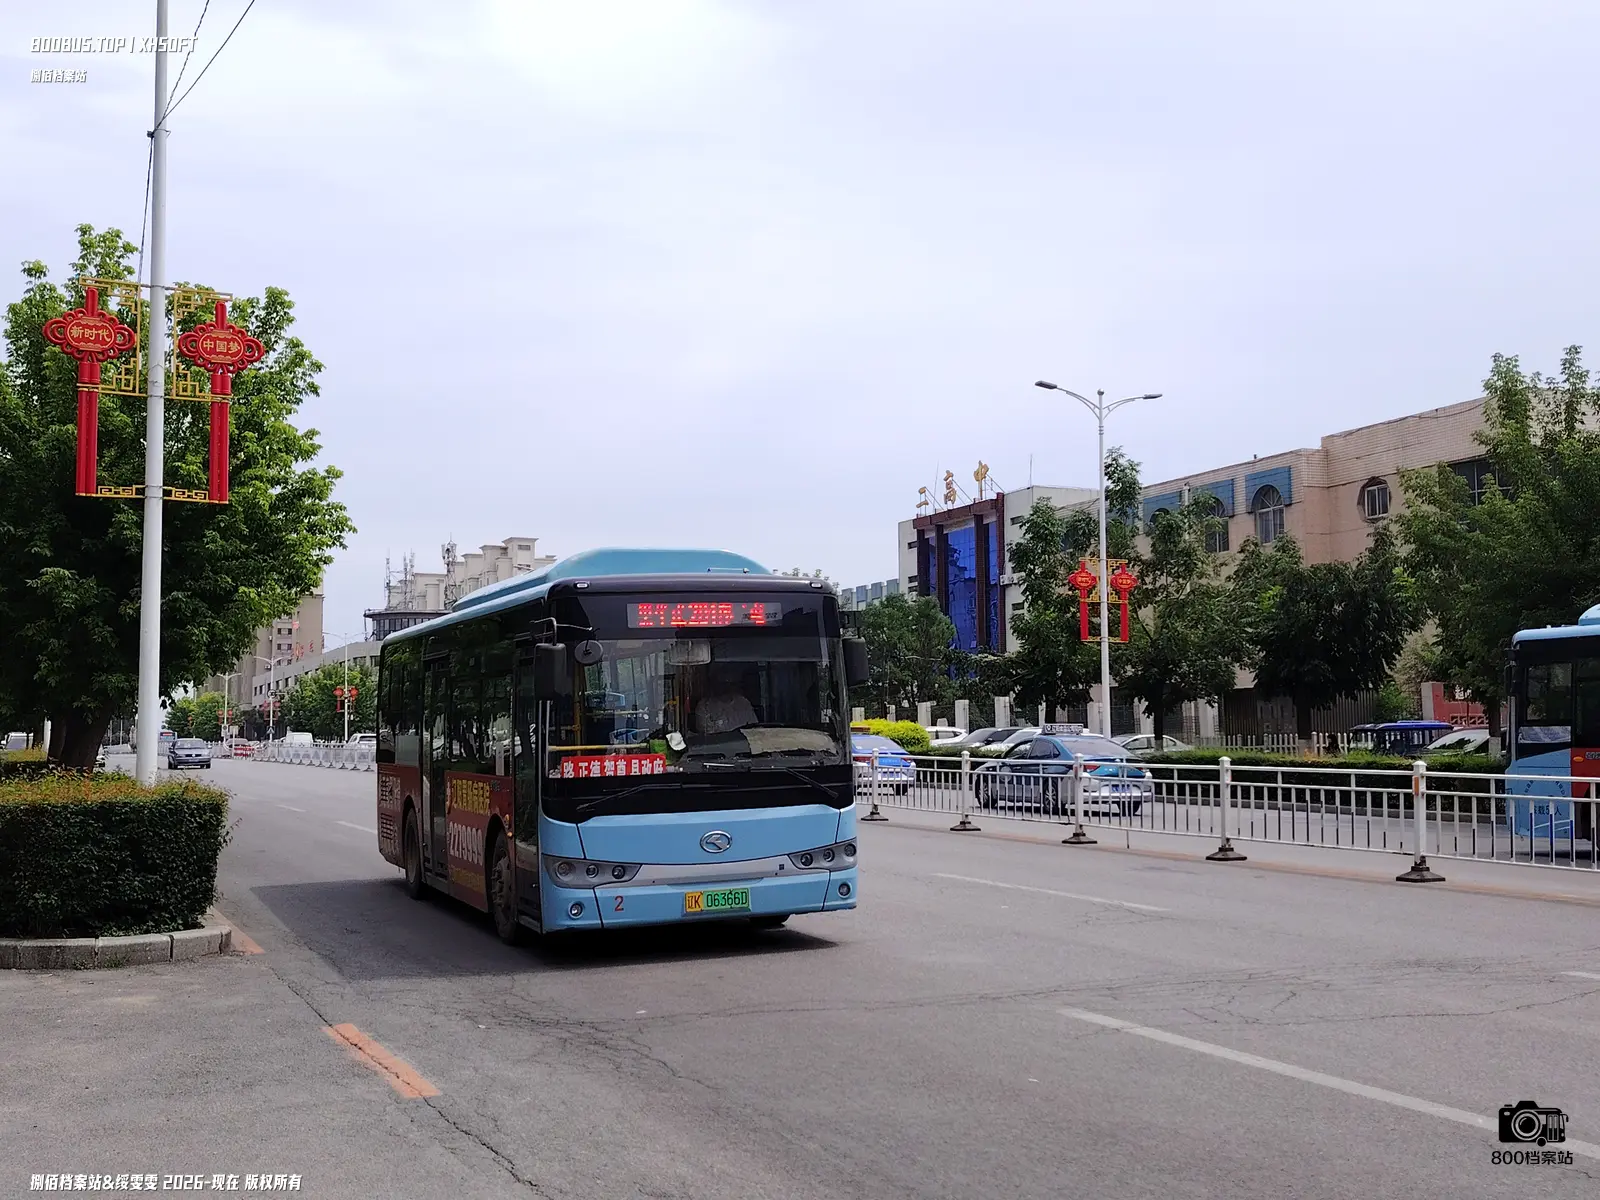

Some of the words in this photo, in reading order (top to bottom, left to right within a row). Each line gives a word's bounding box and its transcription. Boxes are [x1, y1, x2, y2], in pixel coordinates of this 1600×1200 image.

[70, 325, 111, 342] 新时代
[203, 339, 241, 353] 中国梦
[614, 895, 624, 911] 2
